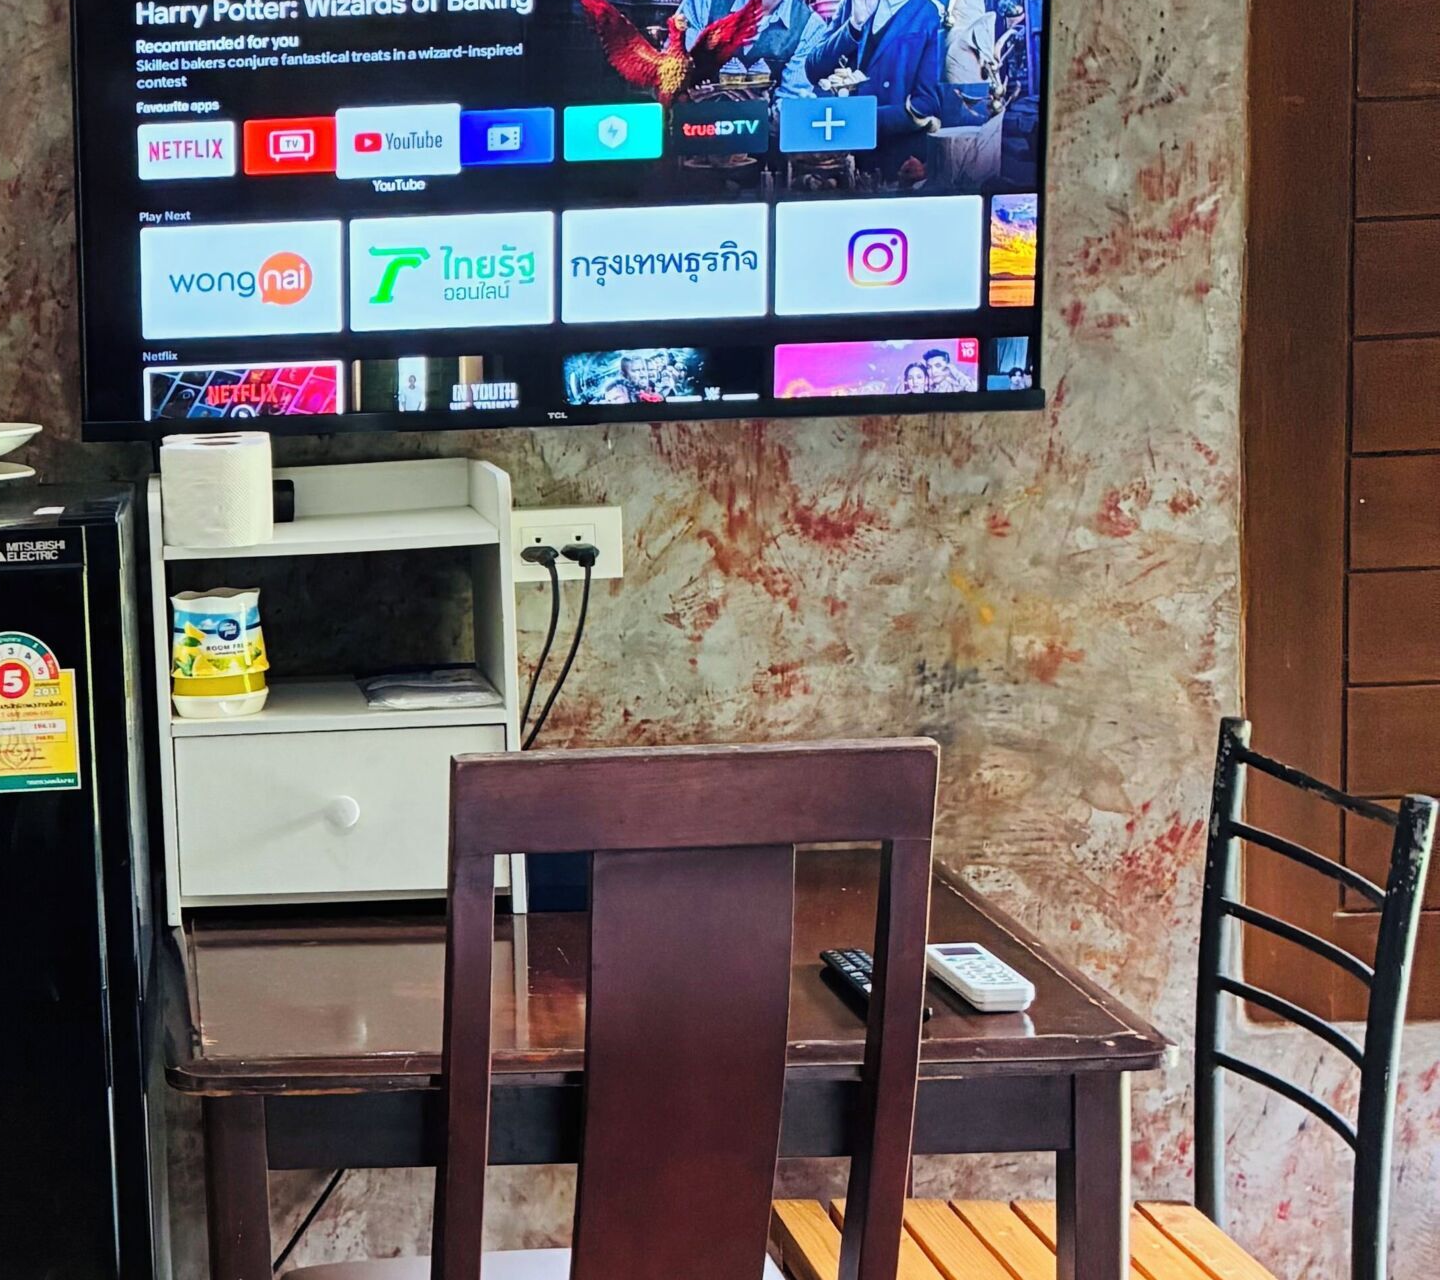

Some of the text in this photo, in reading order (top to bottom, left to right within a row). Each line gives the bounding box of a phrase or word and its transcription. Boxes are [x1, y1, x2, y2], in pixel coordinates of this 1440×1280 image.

[135, 1, 208, 28] Harry
[135, 34, 300, 54] Recommended for you
[135, 43, 523, 72] Skilled bakers conjure fantastical treats in a wizard-inspired
[136, 75, 188, 89] contest
[136, 100, 220, 114] Favourite apps
[285, 139, 299, 149] TV
[385, 130, 443, 151] YouTube
[148, 138, 224, 162] NETFLIX
[372, 179, 426, 193] YouTube
[139, 210, 191, 224] Play Next
[440, 244, 536, 284] ไทยรัฐ
[570, 240, 759, 287] กรุงเทพธุรกิจ
[443, 281, 511, 302] ออนไลน์
[142, 351, 178, 362] Netflix
[962, 348, 975, 358] 10
[207, 384, 279, 405] NETFLIX
[471, 382, 518, 401] YOUTH
[6, 540, 66, 552] MITSUBISHI
[7, 550, 59, 562] ELECTRIC
[8, 647, 15, 656] 3
[24, 652, 31, 660] 4
[37, 667, 44, 675] 5
[3, 668, 24, 694] 5
